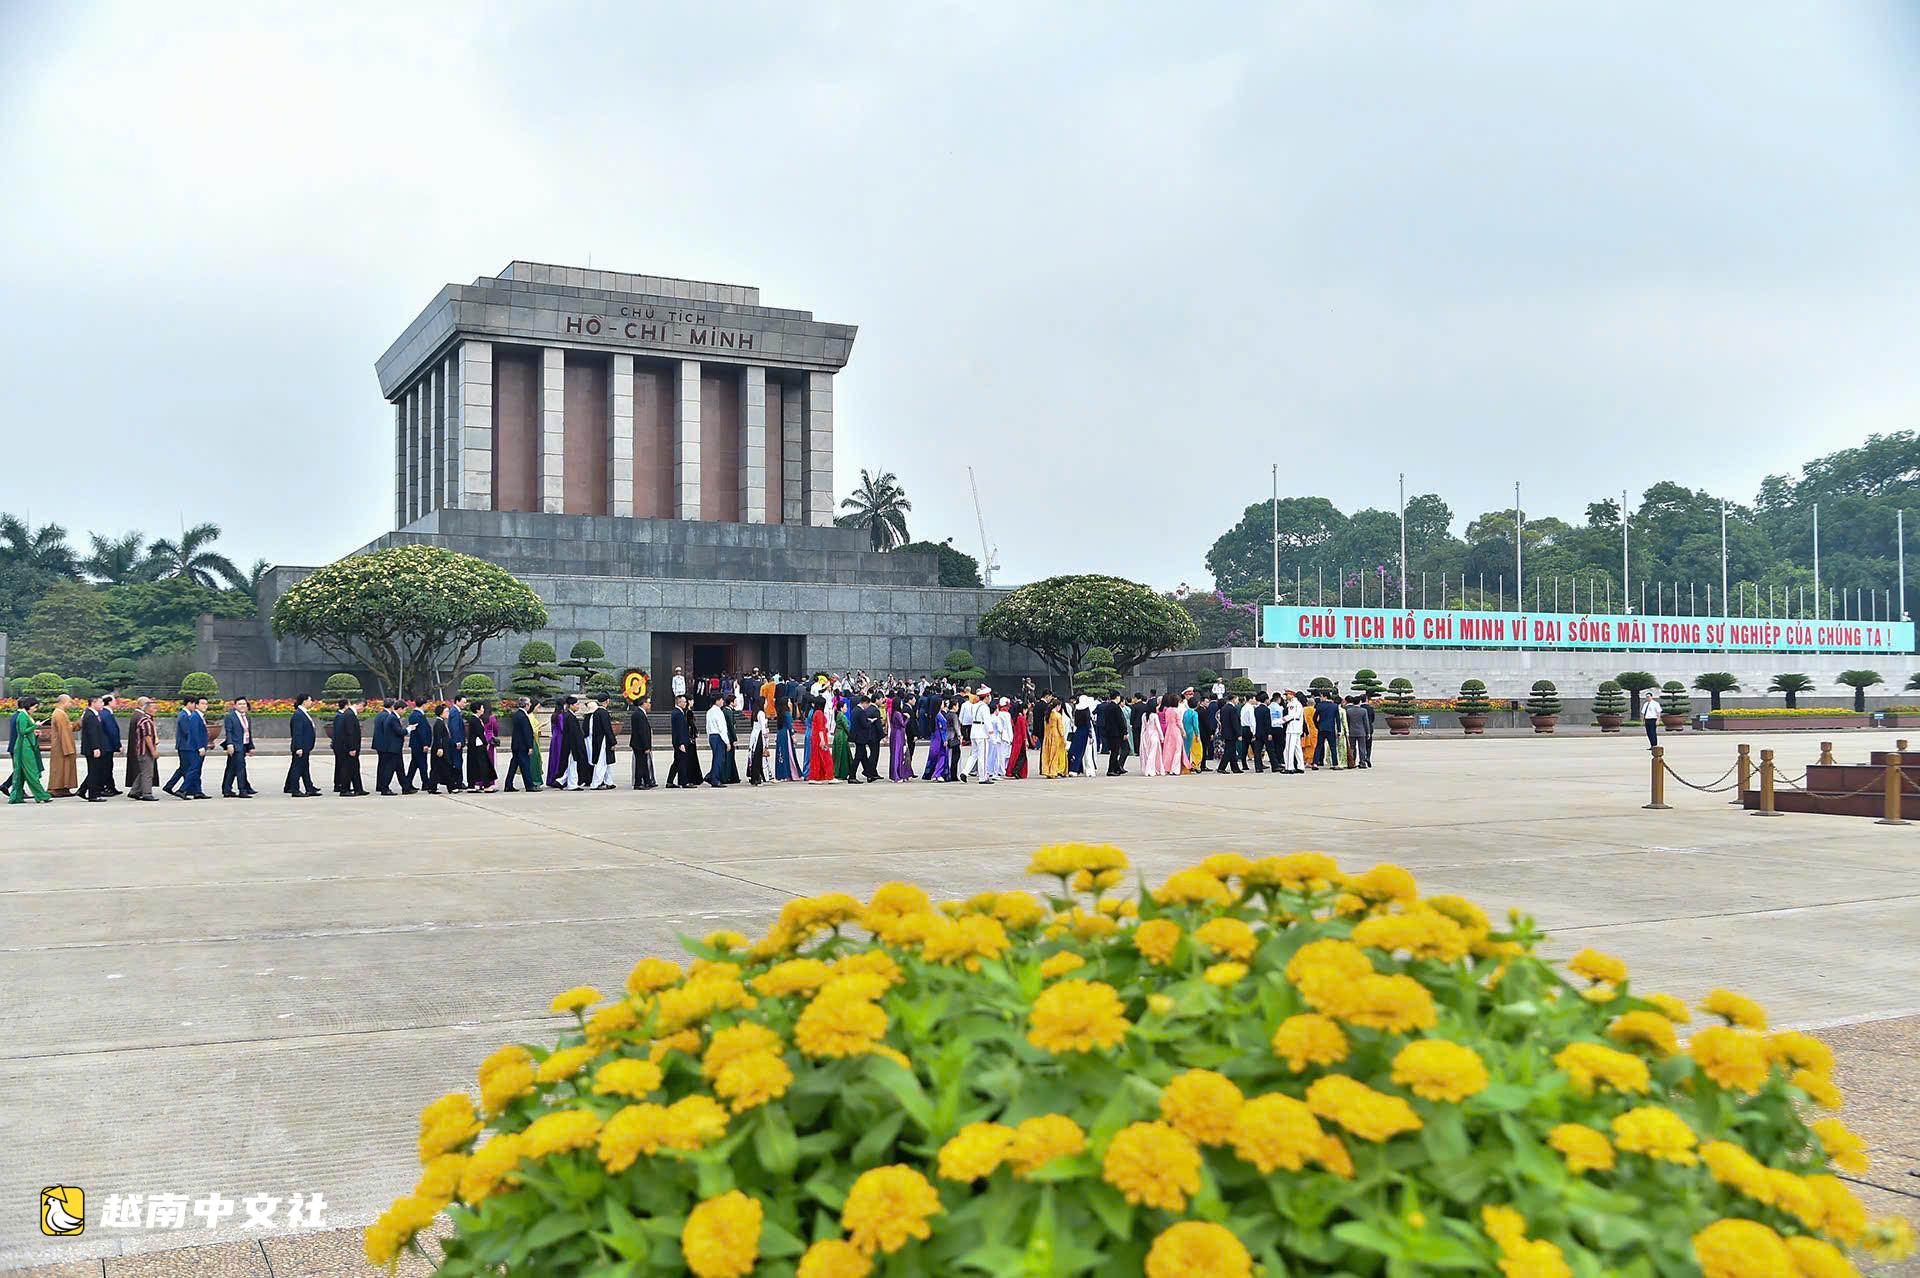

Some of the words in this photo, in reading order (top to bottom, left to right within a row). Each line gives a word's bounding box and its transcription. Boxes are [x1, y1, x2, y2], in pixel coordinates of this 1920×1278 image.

[1298, 608, 1336, 638] CHỦ
[1343, 615, 1385, 643] TỊCH
[1392, 608, 1416, 640] HỒ
[1423, 613, 1452, 640] CHÍ
[1460, 618, 1504, 641] MINH
[1511, 616, 1527, 641] VĨ
[1534, 620, 1561, 646] ĐẠI
[1568, 614, 1611, 643] SỐNG
[1617, 619, 1646, 643] MÃI
[1652, 623, 1701, 644] TRONG
[1706, 622, 1726, 648] SỰ
[1730, 621, 1781, 649] NGHIỆP
[1786, 621, 1813, 646] CỦA
[1817, 623, 1862, 647] CHÚNG
[1866, 627, 1882, 647] TA
